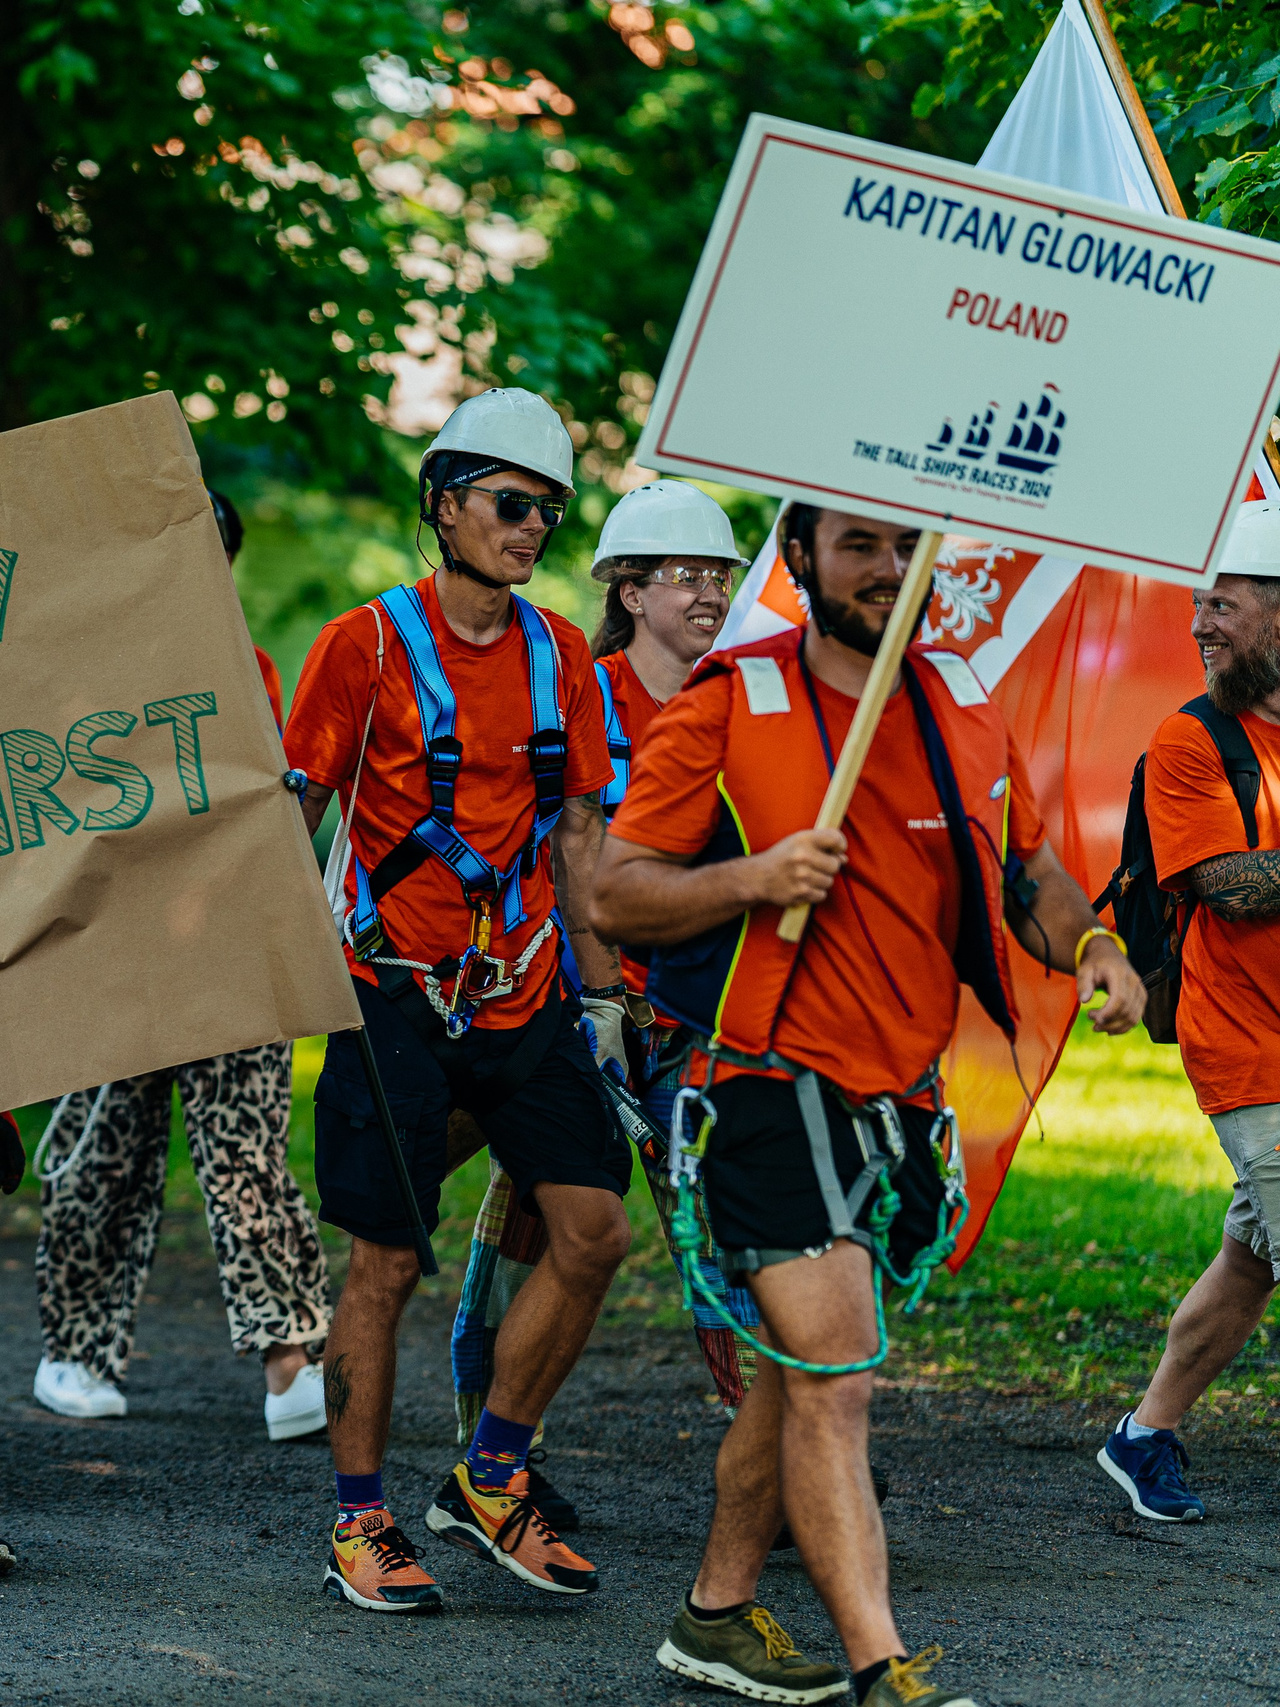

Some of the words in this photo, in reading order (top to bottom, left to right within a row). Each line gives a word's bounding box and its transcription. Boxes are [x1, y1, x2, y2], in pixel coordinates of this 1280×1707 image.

[843, 176, 1016, 255] KAPITAN
[1021, 221, 1215, 304] GLOWACKI
[946, 287, 1068, 343] POLAND
[852, 440, 882, 462] THE
[885, 447, 918, 470] TALL
[921, 456, 968, 480] SHIPS
[969, 467, 1019, 492] RACES
[1020, 479, 1052, 499] 2024
